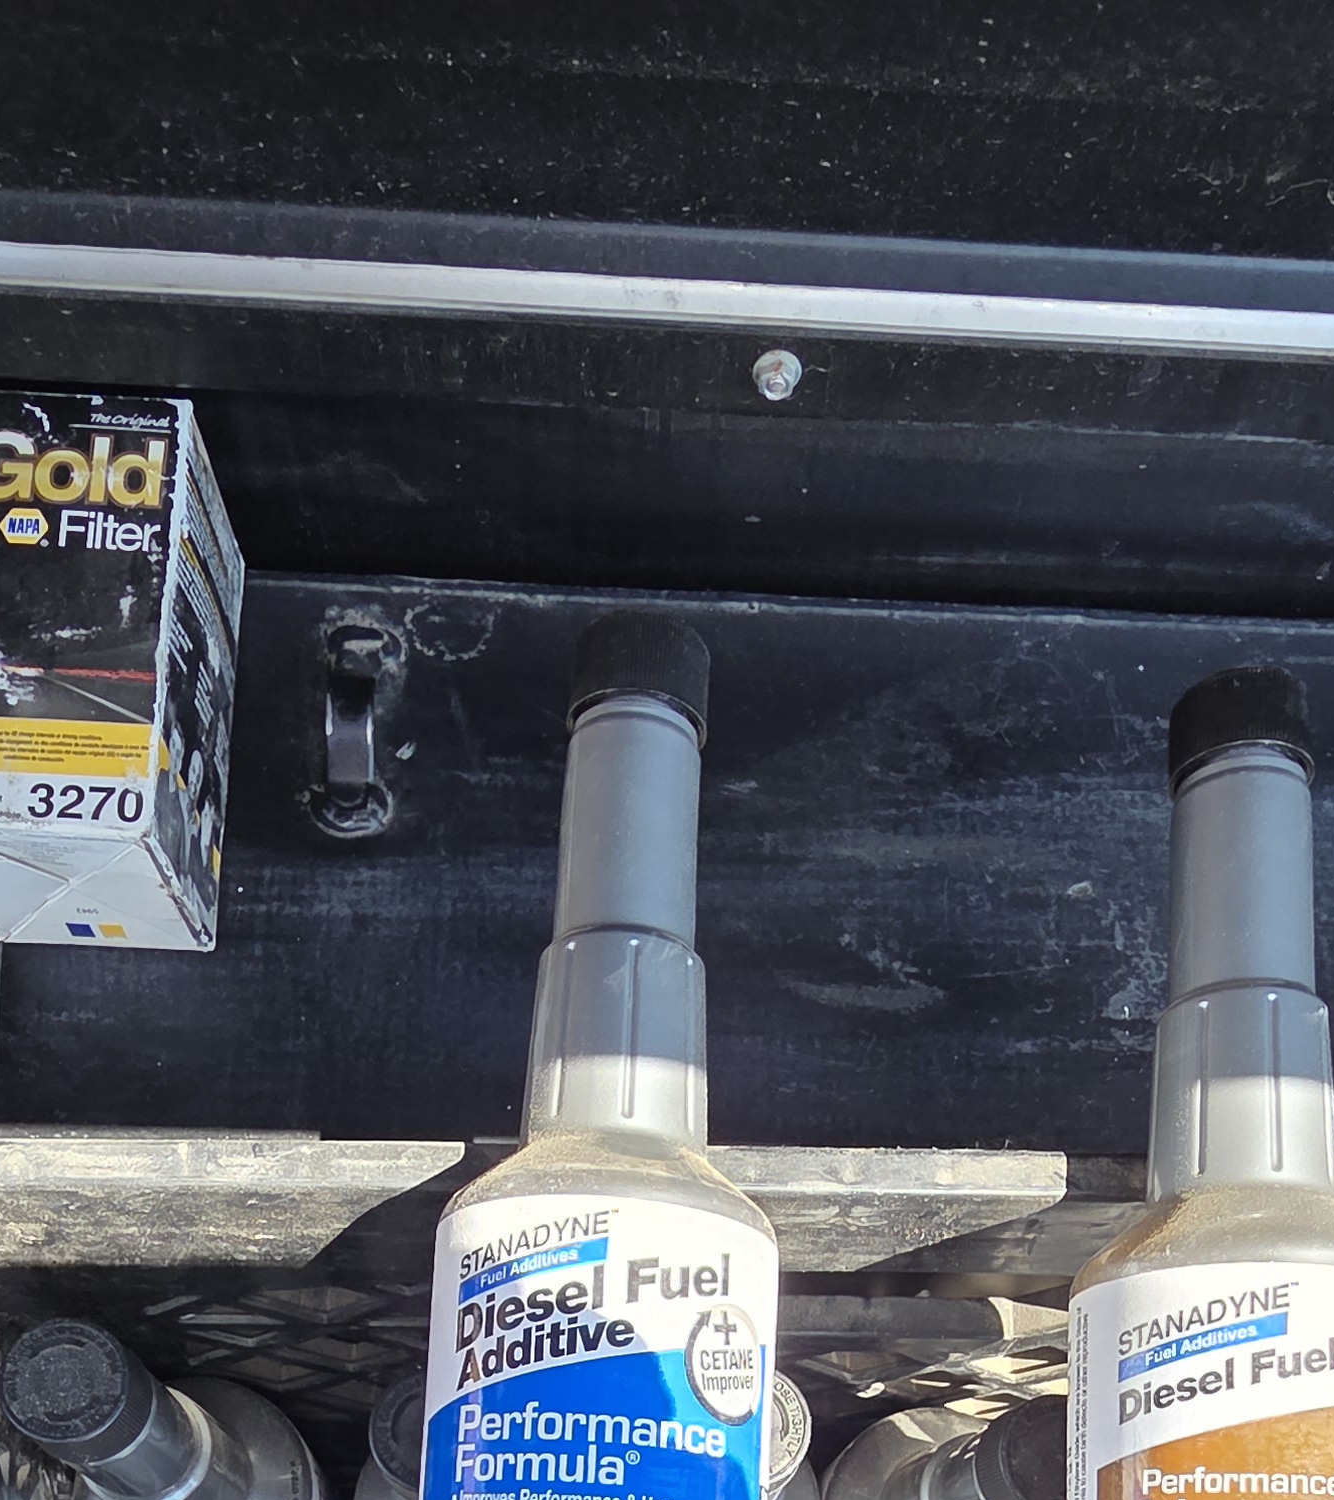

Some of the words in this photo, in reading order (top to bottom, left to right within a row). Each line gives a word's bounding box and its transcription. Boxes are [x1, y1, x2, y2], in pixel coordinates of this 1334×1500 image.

[111, 414, 170, 428] Original
[8, 517, 40, 535] NAPA
[58, 510, 161, 552] Filter
[28, 783, 144, 822] 3270
[459, 1210, 610, 1280] STANADYNE
[480, 1266, 506, 1288] Fuel
[510, 1248, 578, 1275] Additives
[456, 1264, 604, 1354] Diesel
[626, 1253, 730, 1304] Fuel
[1118, 1283, 1290, 1356] STANADYNE
[457, 1316, 635, 1391] Additive
[701, 1349, 753, 1371] CETANE
[1146, 1344, 1176, 1367] Fuel
[1180, 1324, 1258, 1354] Additives
[702, 1373, 753, 1394] Improver
[1119, 1358, 1235, 1426] Diesel
[458, 1401, 727, 1458] Performance
